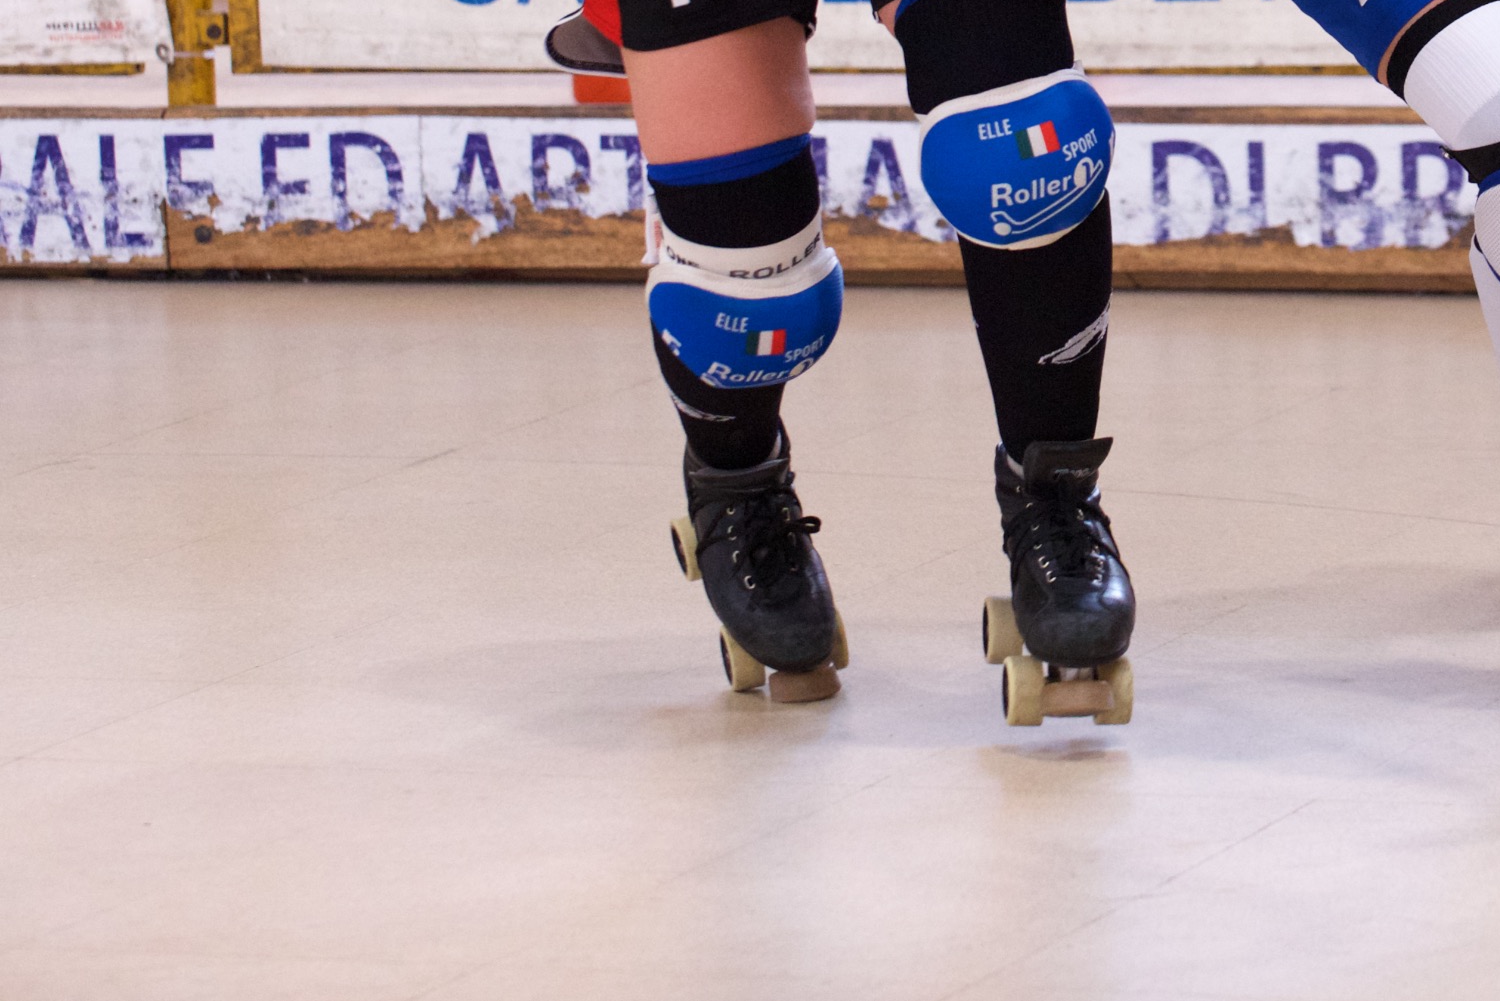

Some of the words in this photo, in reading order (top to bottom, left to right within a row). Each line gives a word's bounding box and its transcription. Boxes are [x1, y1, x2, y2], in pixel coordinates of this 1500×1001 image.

[977, 119, 1013, 141] ELLE
[1062, 128, 1099, 162] SPORT
[715, 312, 750, 334] ELLE
[784, 335, 825, 364] SPORT
